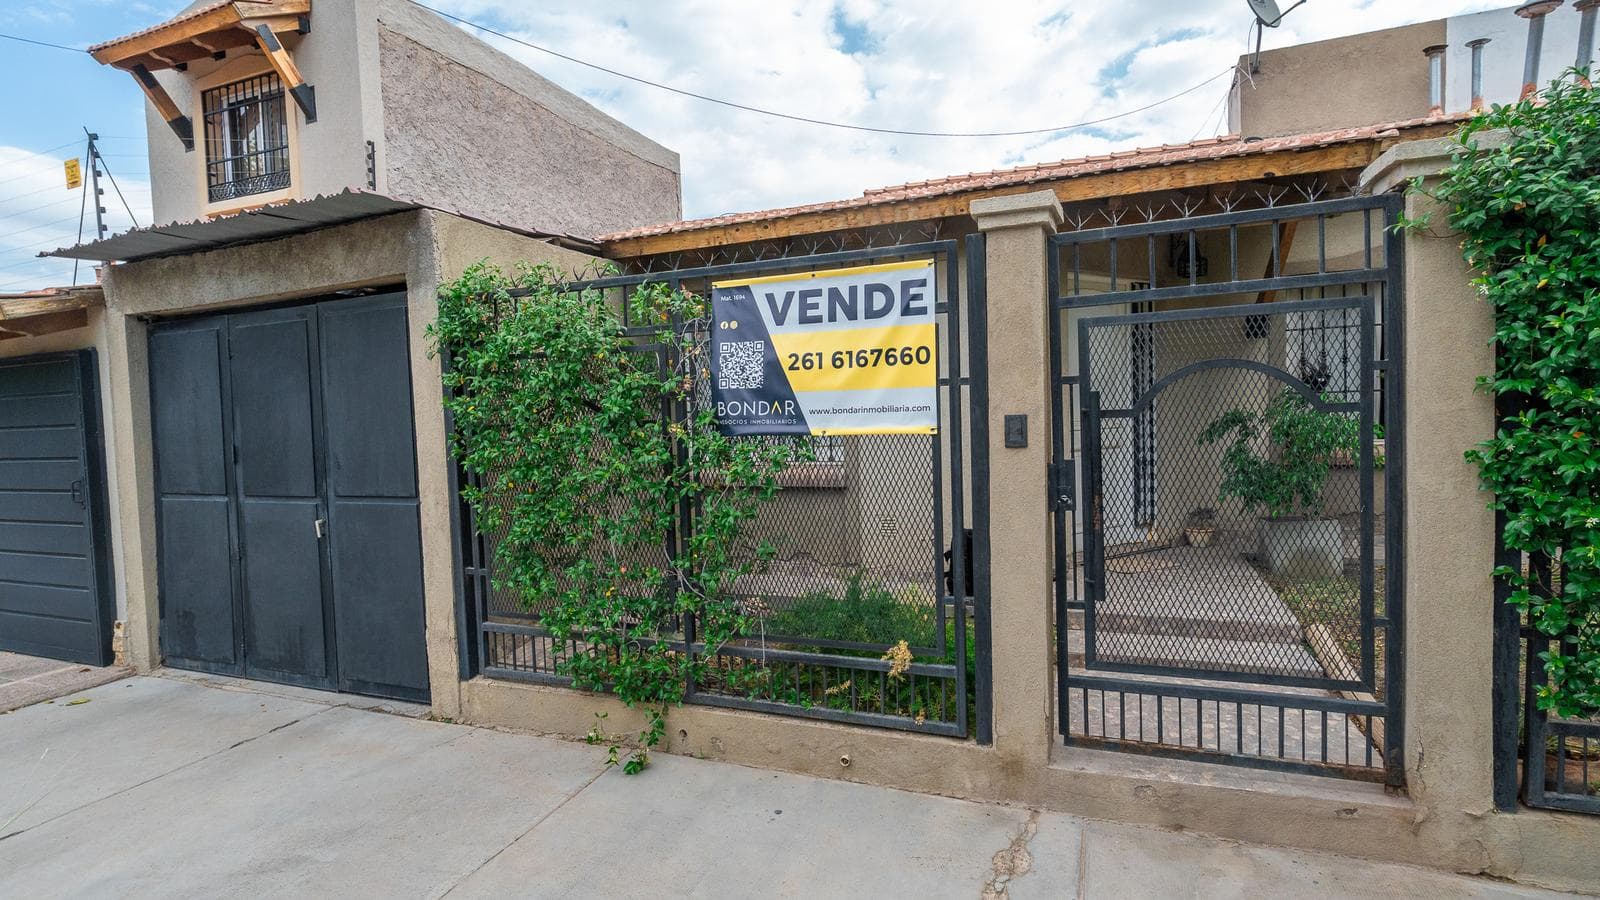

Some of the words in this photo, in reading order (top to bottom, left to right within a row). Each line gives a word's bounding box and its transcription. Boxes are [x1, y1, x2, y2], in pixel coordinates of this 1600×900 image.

[764, 278, 928, 326] VENDE
[787, 351, 823, 371] 261
[831, 345, 931, 369] 6167660
[717, 400, 796, 417] BONDAR
[808, 404, 931, 415] www.bondarinmobiliaria.com
